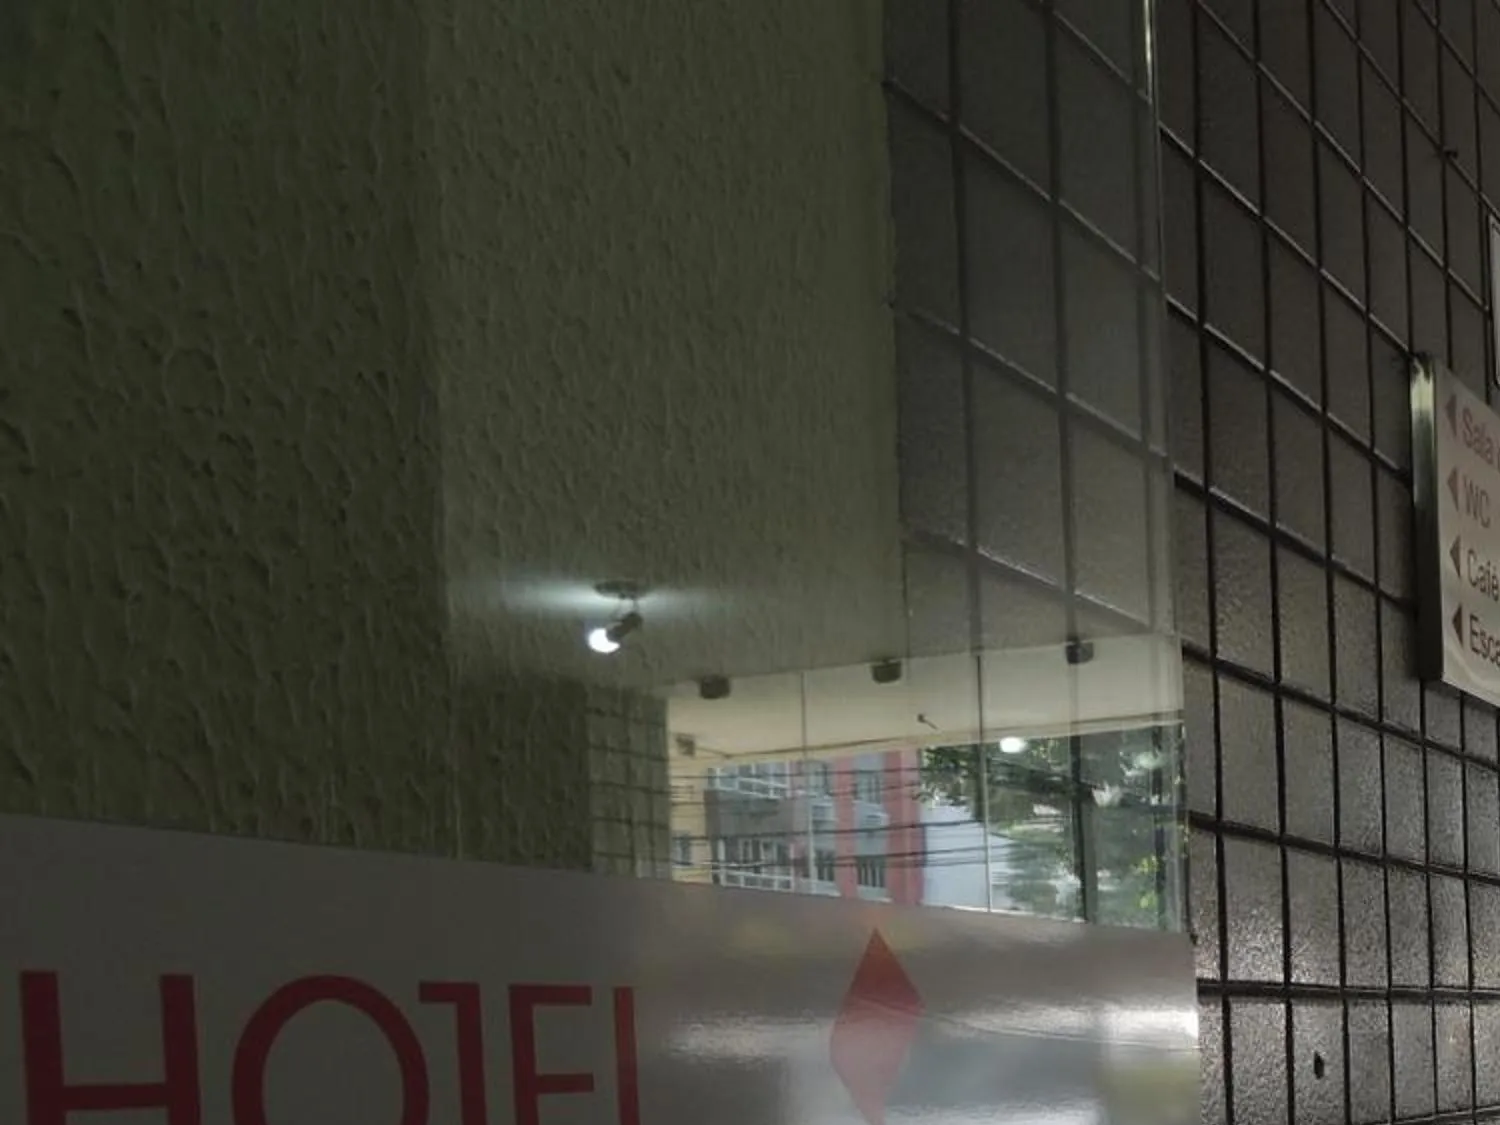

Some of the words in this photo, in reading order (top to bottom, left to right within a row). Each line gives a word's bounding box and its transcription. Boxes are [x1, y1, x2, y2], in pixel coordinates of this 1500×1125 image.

[1462, 407, 1494, 465] Sala
[1463, 475, 1492, 529] WC
[1467, 548, 1500, 602] Café
